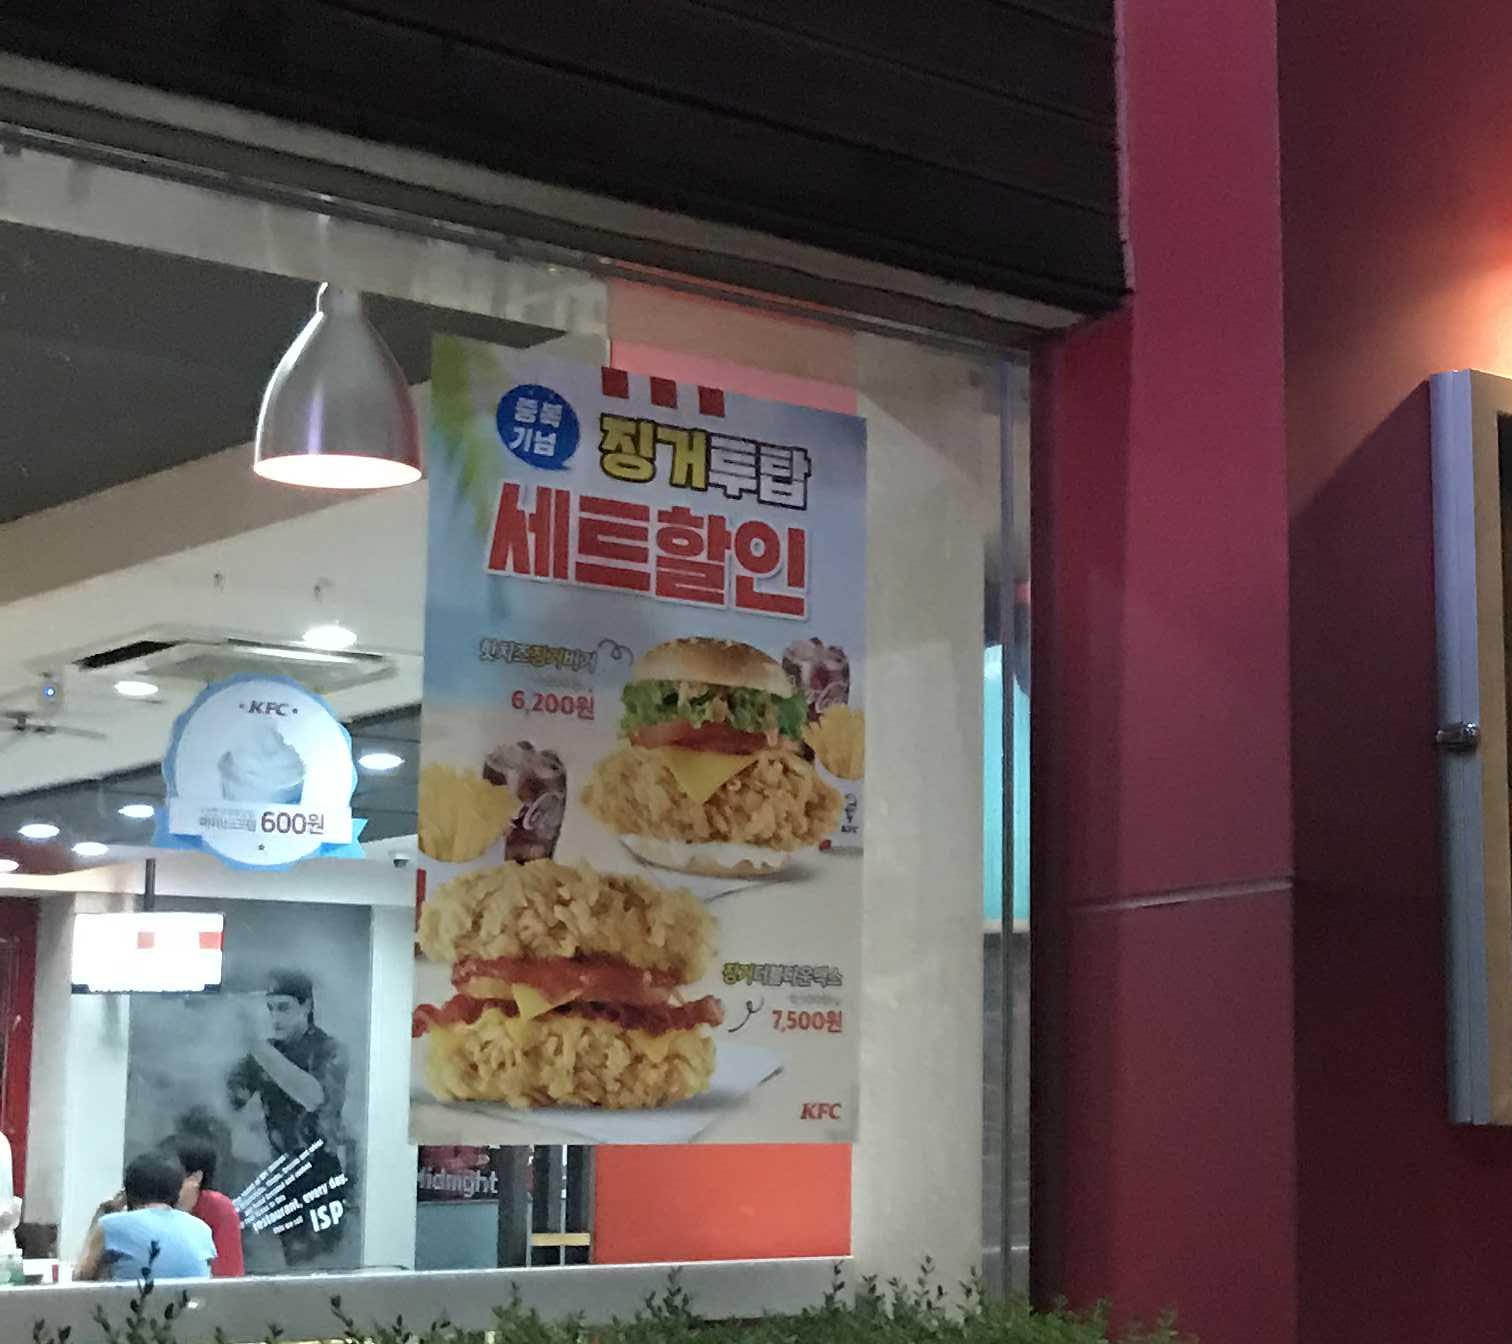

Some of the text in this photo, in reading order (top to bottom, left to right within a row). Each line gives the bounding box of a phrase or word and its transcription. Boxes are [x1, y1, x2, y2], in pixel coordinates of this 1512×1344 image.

[488, 482, 808, 620] 세트할인
[248, 700, 289, 716] KFC
[511, 689, 595, 721] 6,200원
[261, 811, 324, 835] 600원
[772, 1010, 843, 1034] 7,500원
[800, 1102, 842, 1121] KFC
[309, 1200, 344, 1232] ISP
